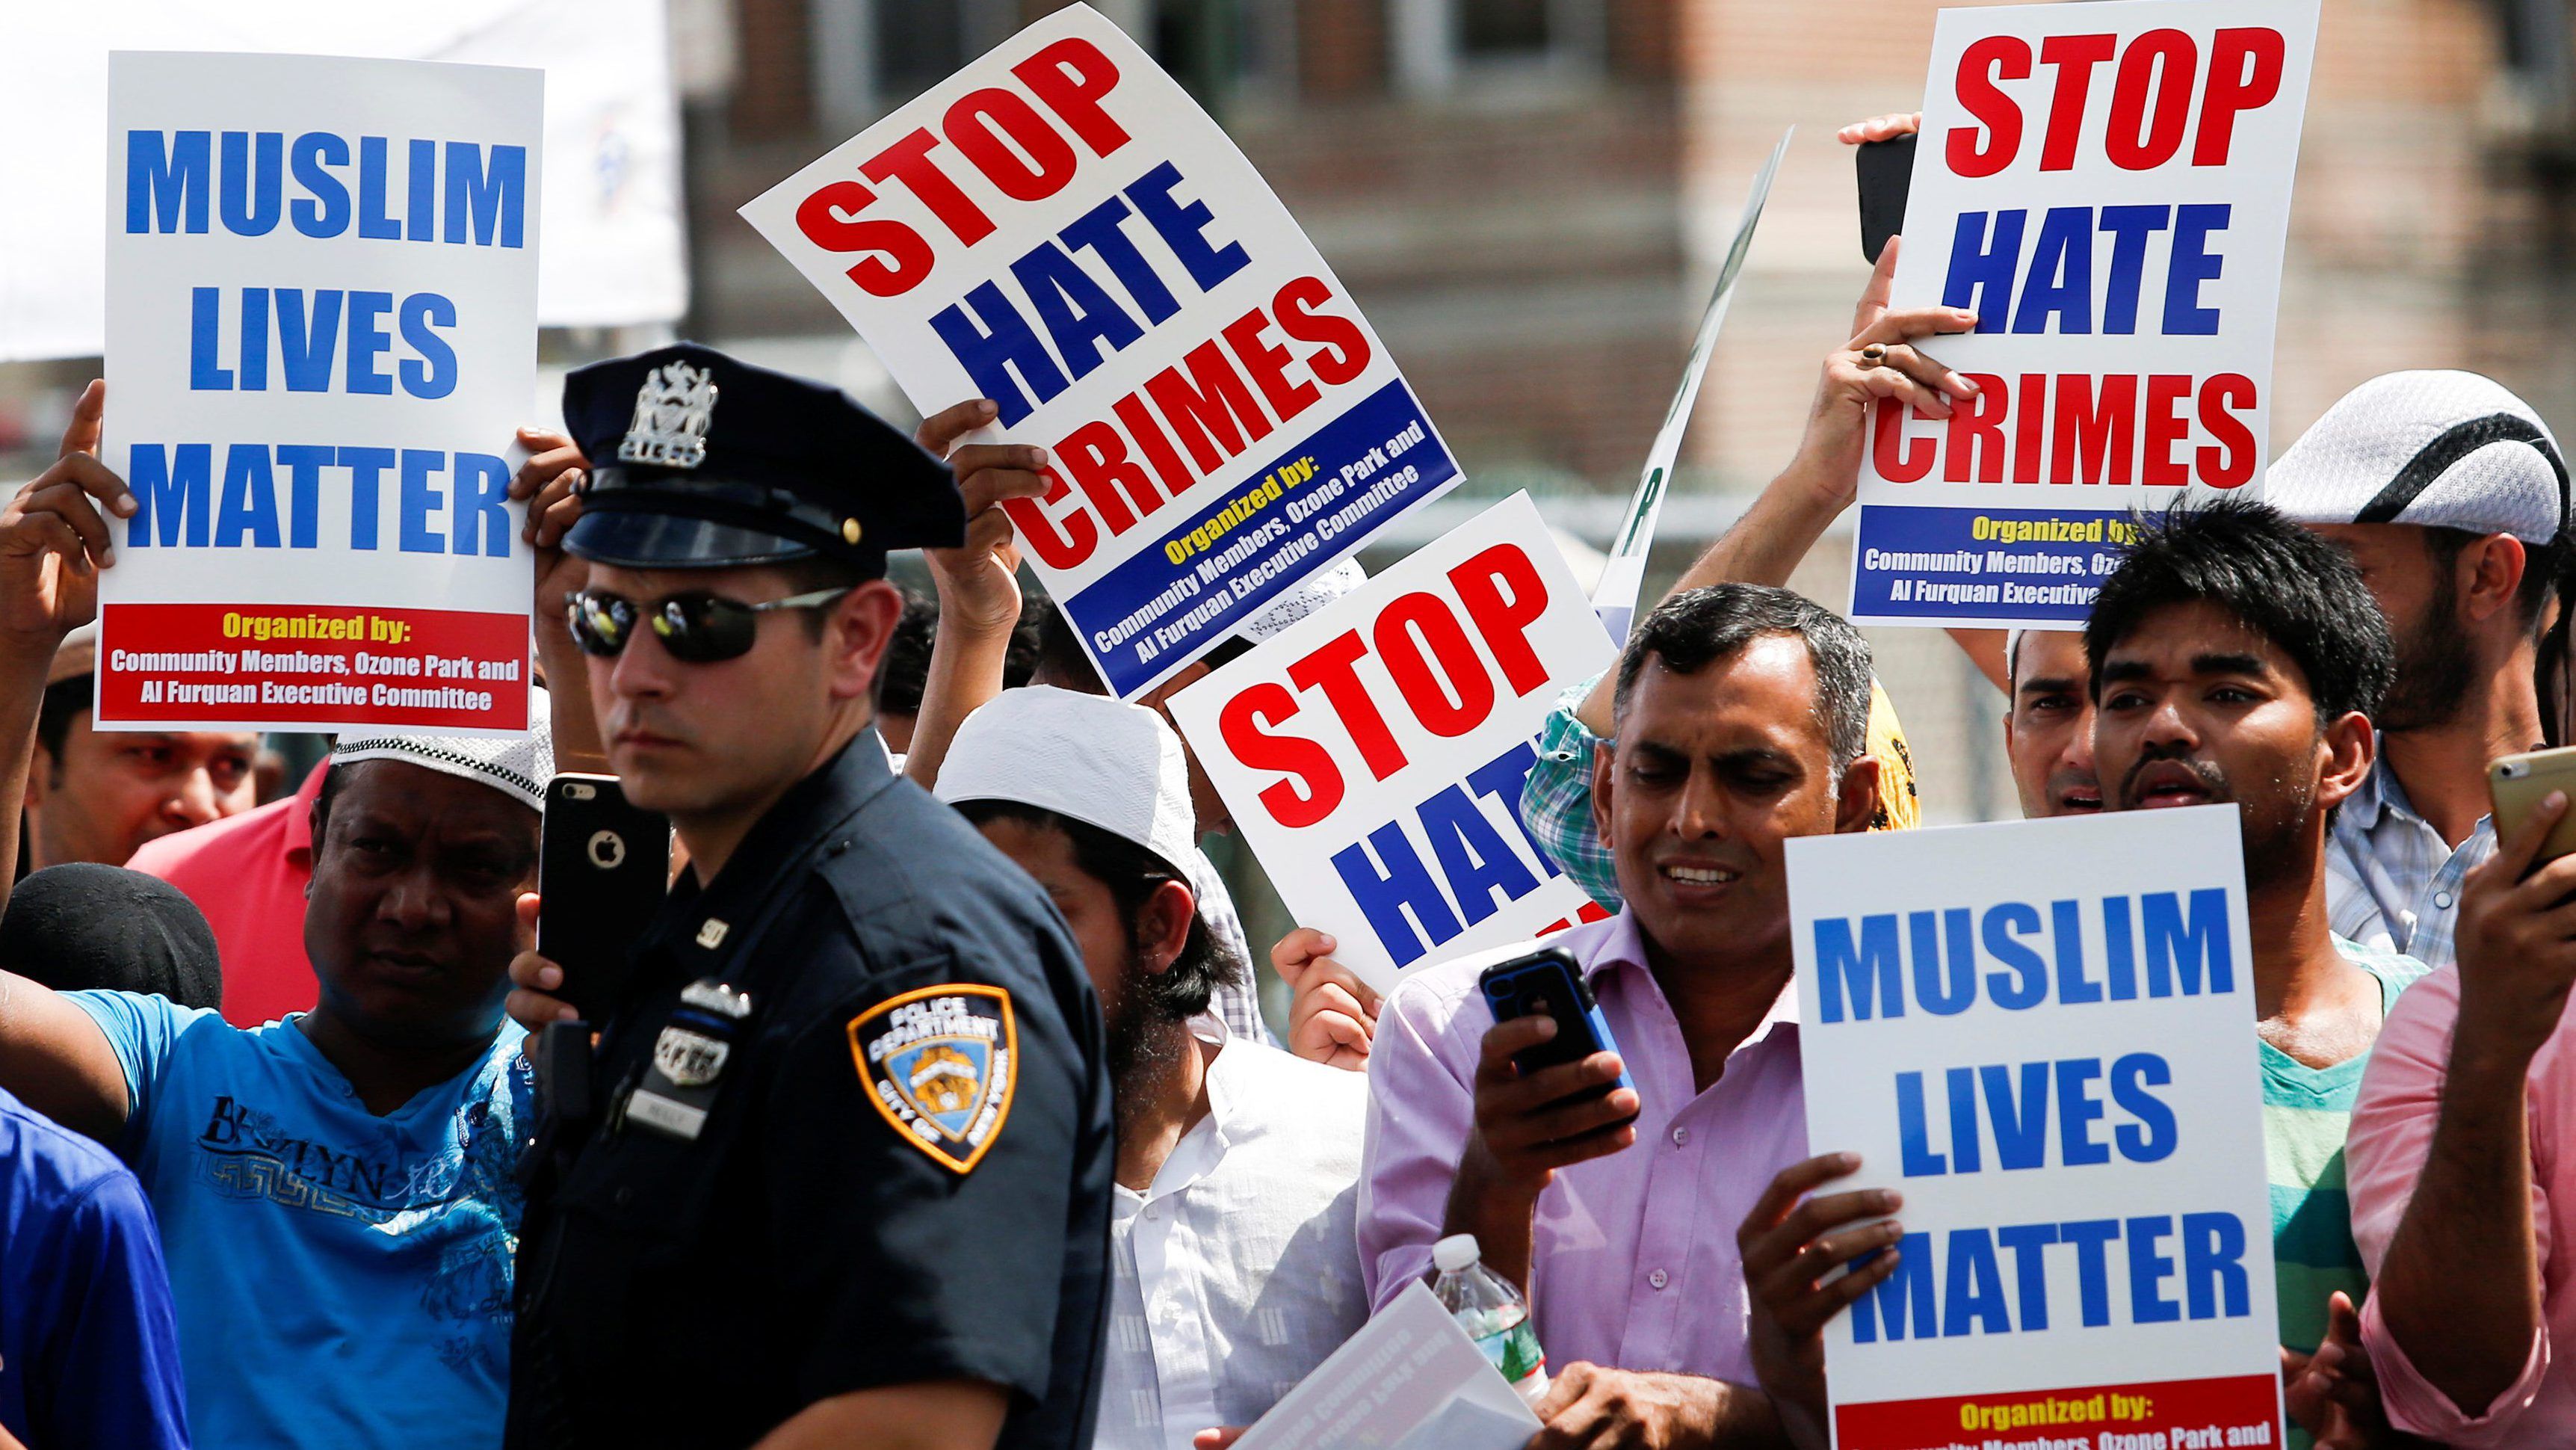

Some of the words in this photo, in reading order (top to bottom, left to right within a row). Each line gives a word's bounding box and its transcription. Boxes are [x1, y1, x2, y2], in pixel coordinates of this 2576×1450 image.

[1945, 27, 2286, 179] STOP
[126, 129, 526, 249] MUSLIM
[795, 37, 1132, 297] STOP
[928, 159, 1253, 431] HATE
[1934, 203, 2231, 336] HATE
[190, 286, 458, 400] LIVES
[1003, 276, 1371, 570] CRIMES
[1872, 373, 2257, 490] CRIMES
[126, 442, 511, 558] MATTER
[1093, 573, 1202, 654] Community
[1195, 516, 1291, 586] Members,
[1285, 477, 1345, 524] Ozone
[1339, 446, 1390, 488] Park
[1385, 419, 1426, 459] and
[1153, 588, 1235, 651] Furquan
[1227, 531, 1320, 600] Executive
[1315, 464, 1420, 541] Committee
[1164, 474, 1283, 565] Organized
[1277, 455, 1321, 490] by:
[1971, 515, 2103, 544] Organized
[1865, 547, 1984, 575] Community
[1985, 549, 2087, 577] Members,
[1913, 579, 1999, 605] Furquan
[111, 649, 238, 674] Community
[241, 650, 350, 676] Members,
[354, 651, 421, 676] Ozone
[424, 654, 475, 679] Park
[478, 658, 519, 682] and
[223, 611, 365, 641] Organized
[370, 615, 412, 644] by:
[167, 680, 257, 706] Furquan
[261, 681, 368, 706] Executive
[371, 682, 493, 711] Committee
[1219, 543, 1550, 829] STOP
[1329, 732, 1563, 969] HAT
[889, 996, 969, 1029] POLICE
[1812, 887, 2234, 1024] MUSLIM
[868, 1014, 999, 1064] DEPARTMENT
[877, 1079, 917, 1121] CITY
[1895, 1052, 2179, 1178] LIVES
[1848, 1211, 2252, 1345] MATTER
[1959, 1393, 2106, 1431] Organized
[2110, 1392, 2155, 1422] by:
[2097, 1431, 2167, 1450] Ozone
[2170, 1424, 2225, 1450] Park
[2226, 1420, 2272, 1447] and
